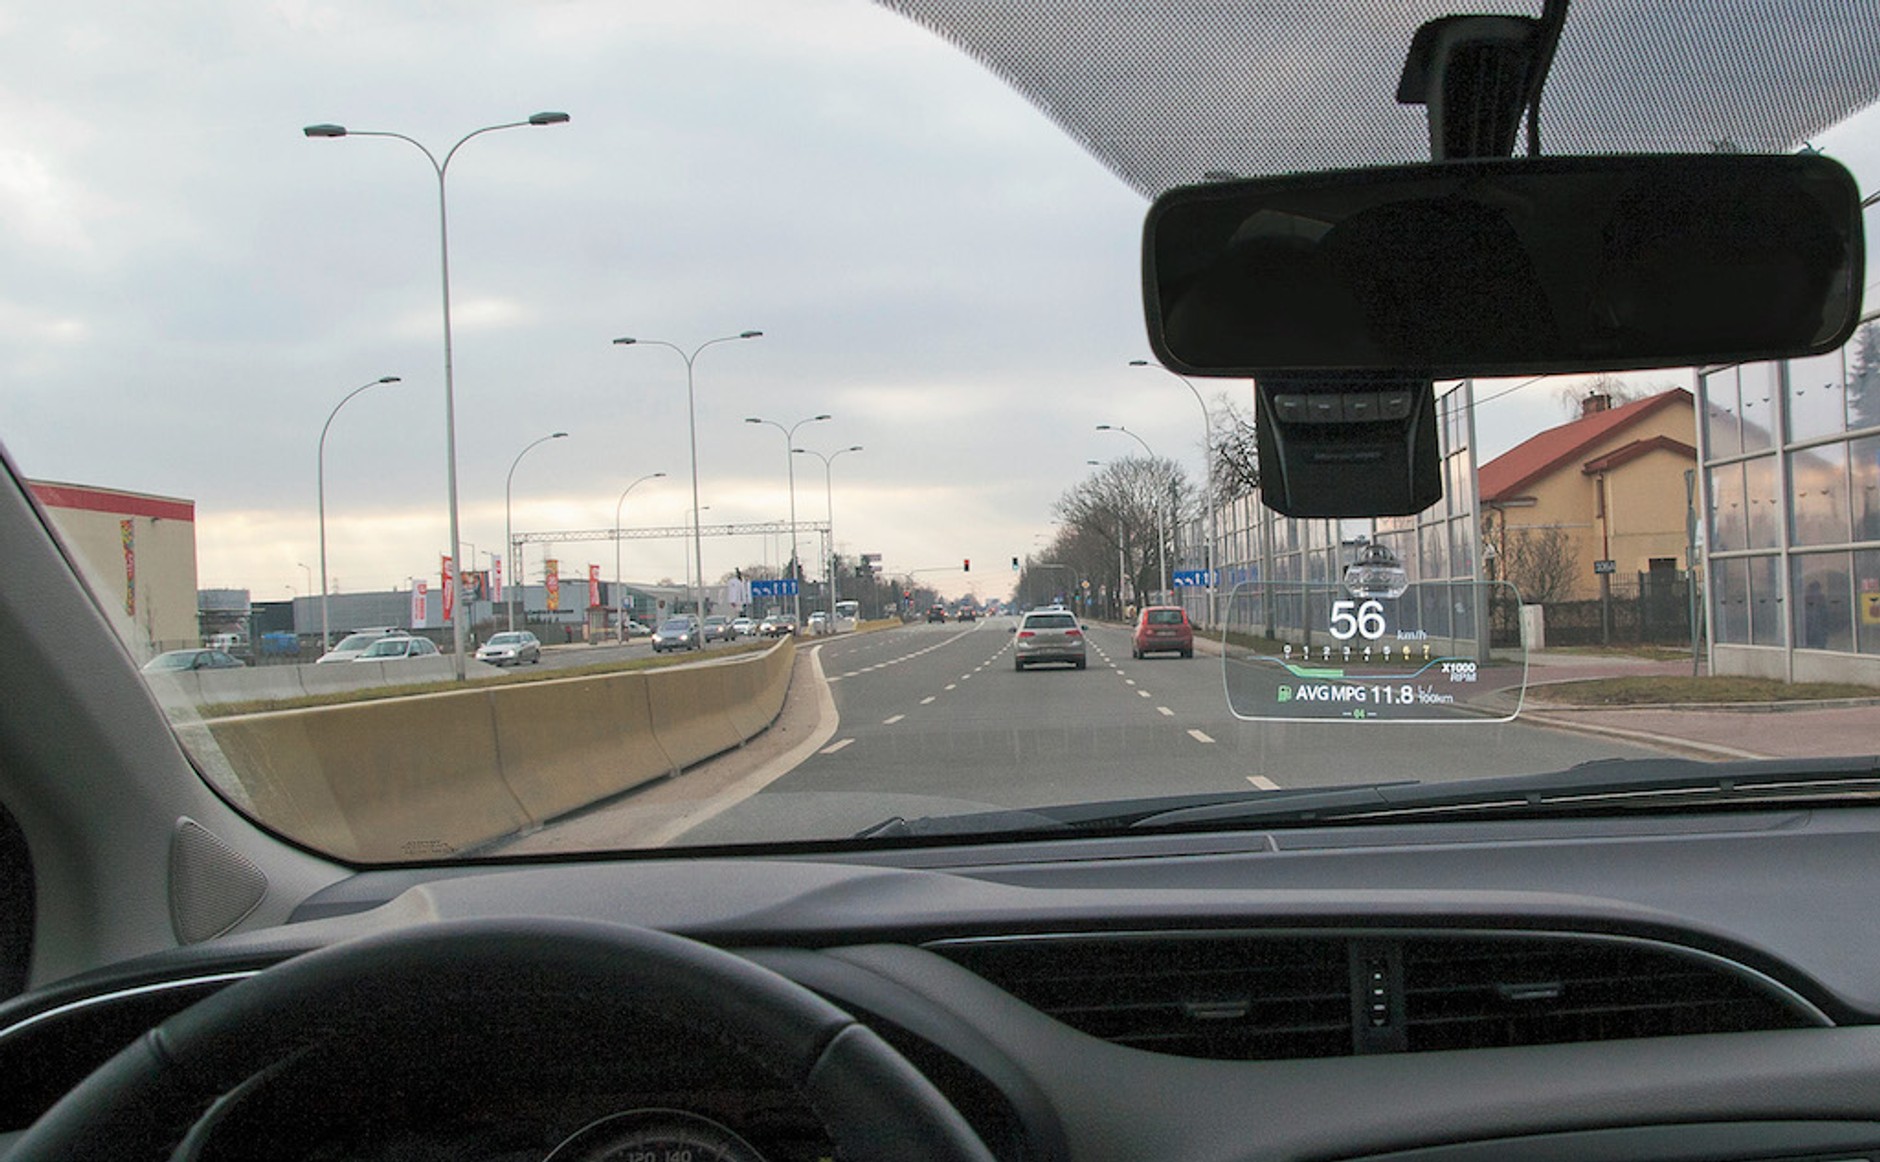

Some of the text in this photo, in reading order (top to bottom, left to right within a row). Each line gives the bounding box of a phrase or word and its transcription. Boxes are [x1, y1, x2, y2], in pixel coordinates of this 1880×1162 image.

[1330, 601, 1386, 640] 56
[1397, 630, 1427, 640] km/h
[1323, 646, 1330, 654] 2
[1343, 646, 1351, 655] 3
[1363, 646, 1371, 655] 4
[1383, 645, 1391, 654] 5
[1403, 645, 1411, 654] 6
[1423, 644, 1430, 653] 7
[1450, 672, 1477, 682] RPM
[1296, 685, 1413, 704] AVG MPG 11.8
[666, 1151, 692, 1162] 140
